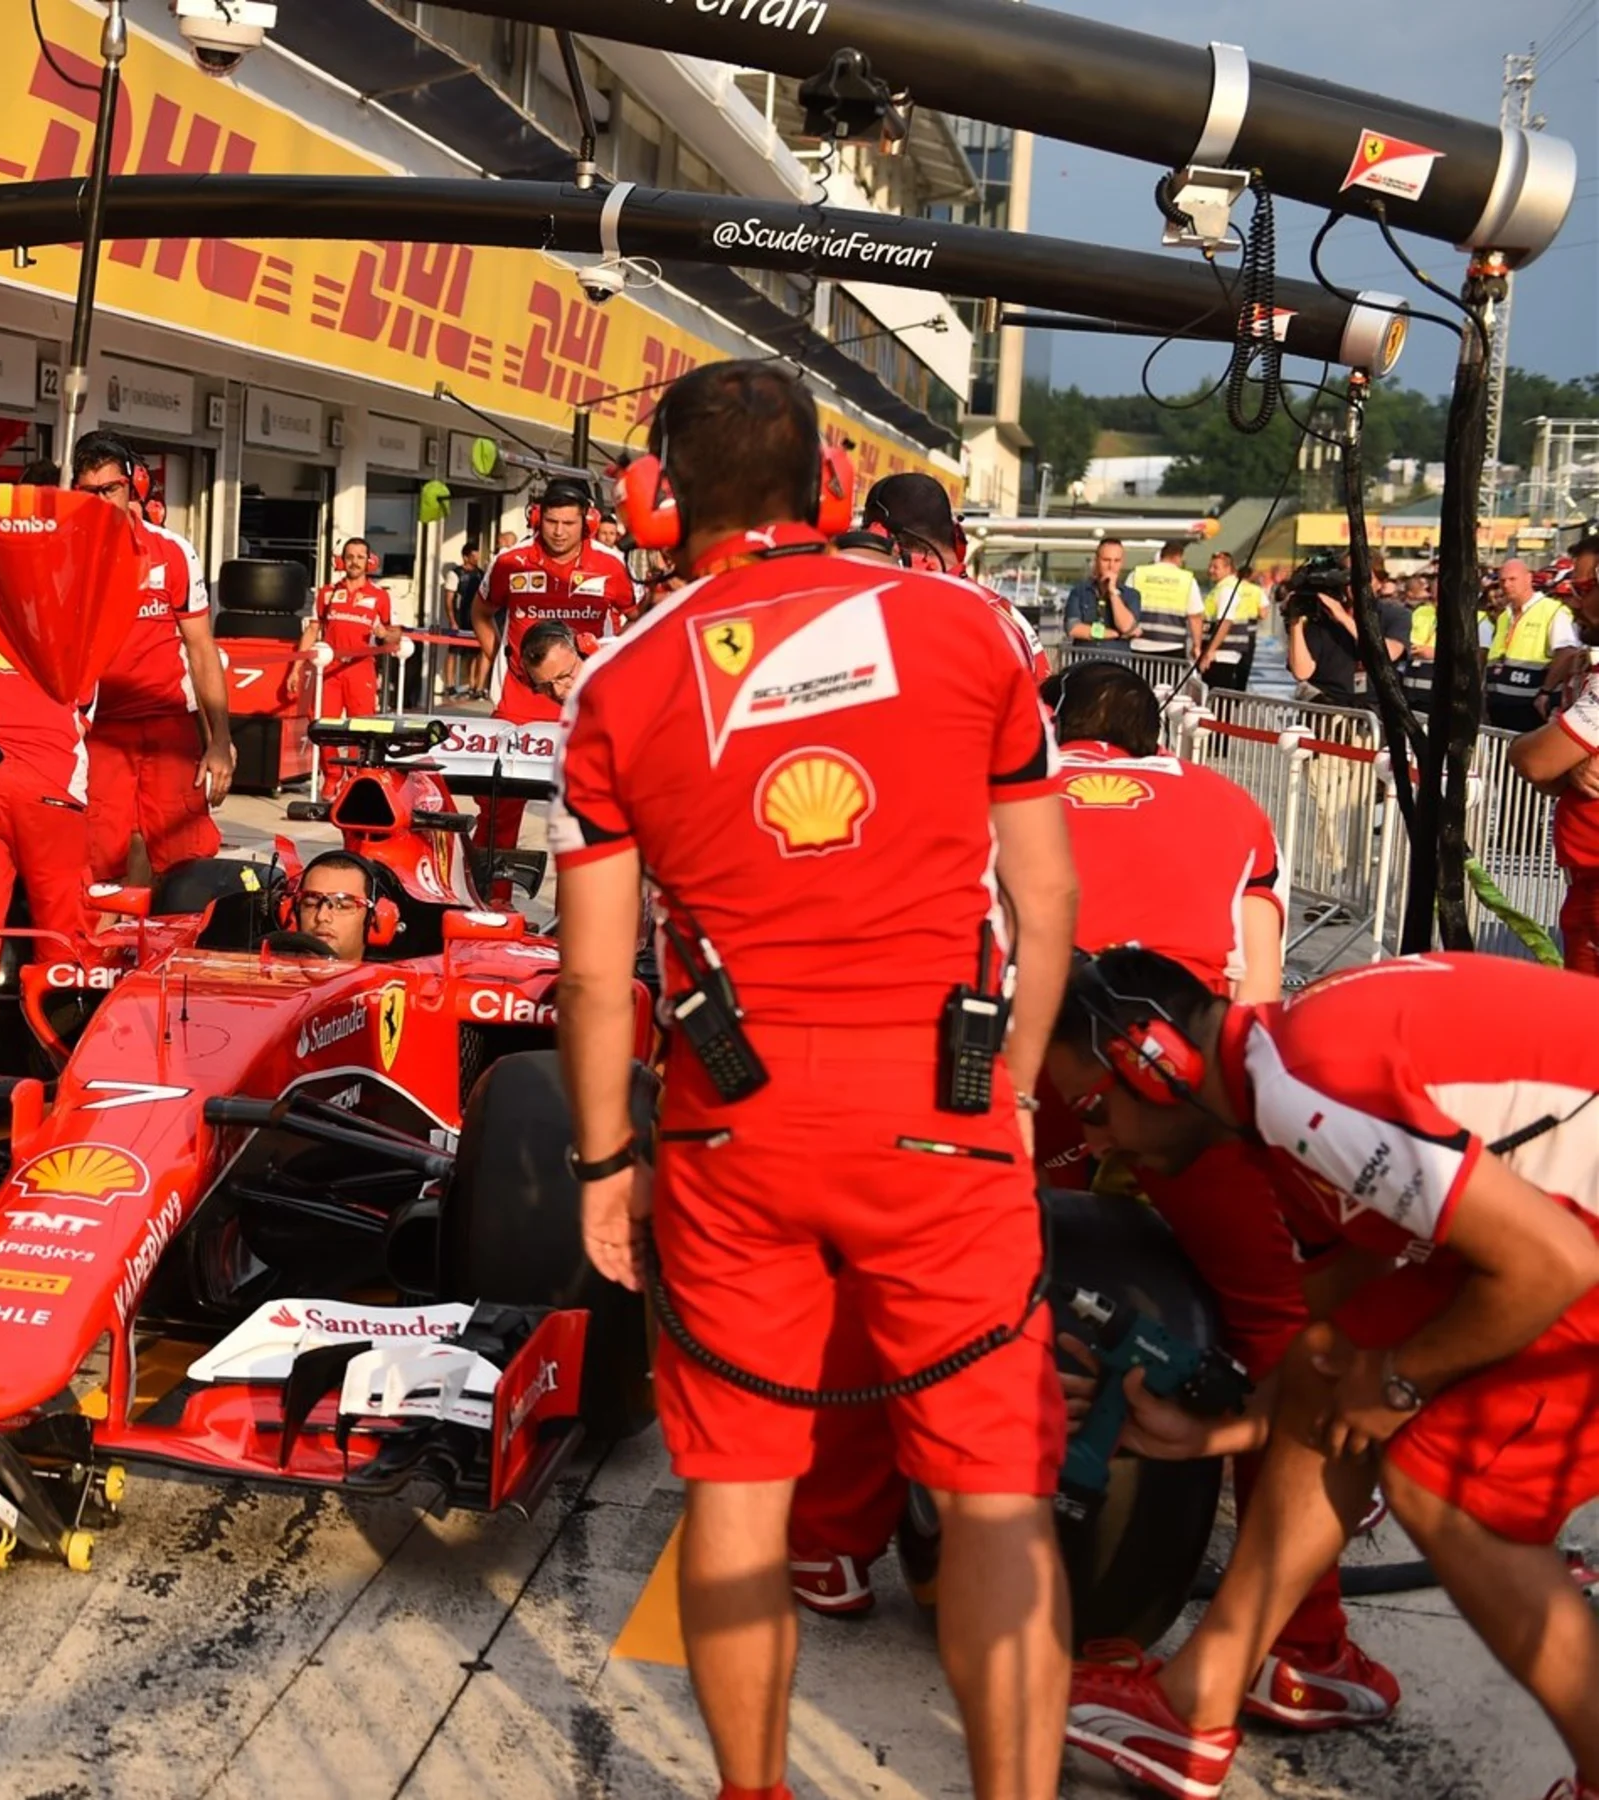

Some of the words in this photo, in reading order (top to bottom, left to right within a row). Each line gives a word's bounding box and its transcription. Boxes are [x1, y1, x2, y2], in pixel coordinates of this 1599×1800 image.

[713, 217, 938, 269] @ScuderiaFerrari
[520, 280, 609, 410] DHL
[43, 368, 58, 395] 22
[527, 605, 602, 620] Santander
[233, 667, 264, 689] 7
[46, 963, 122, 989] Clar
[310, 1005, 368, 1052] Santander
[82, 1080, 191, 1109] 7
[4, 1210, 103, 1233] TNT
[305, 1308, 460, 1338] Santander
